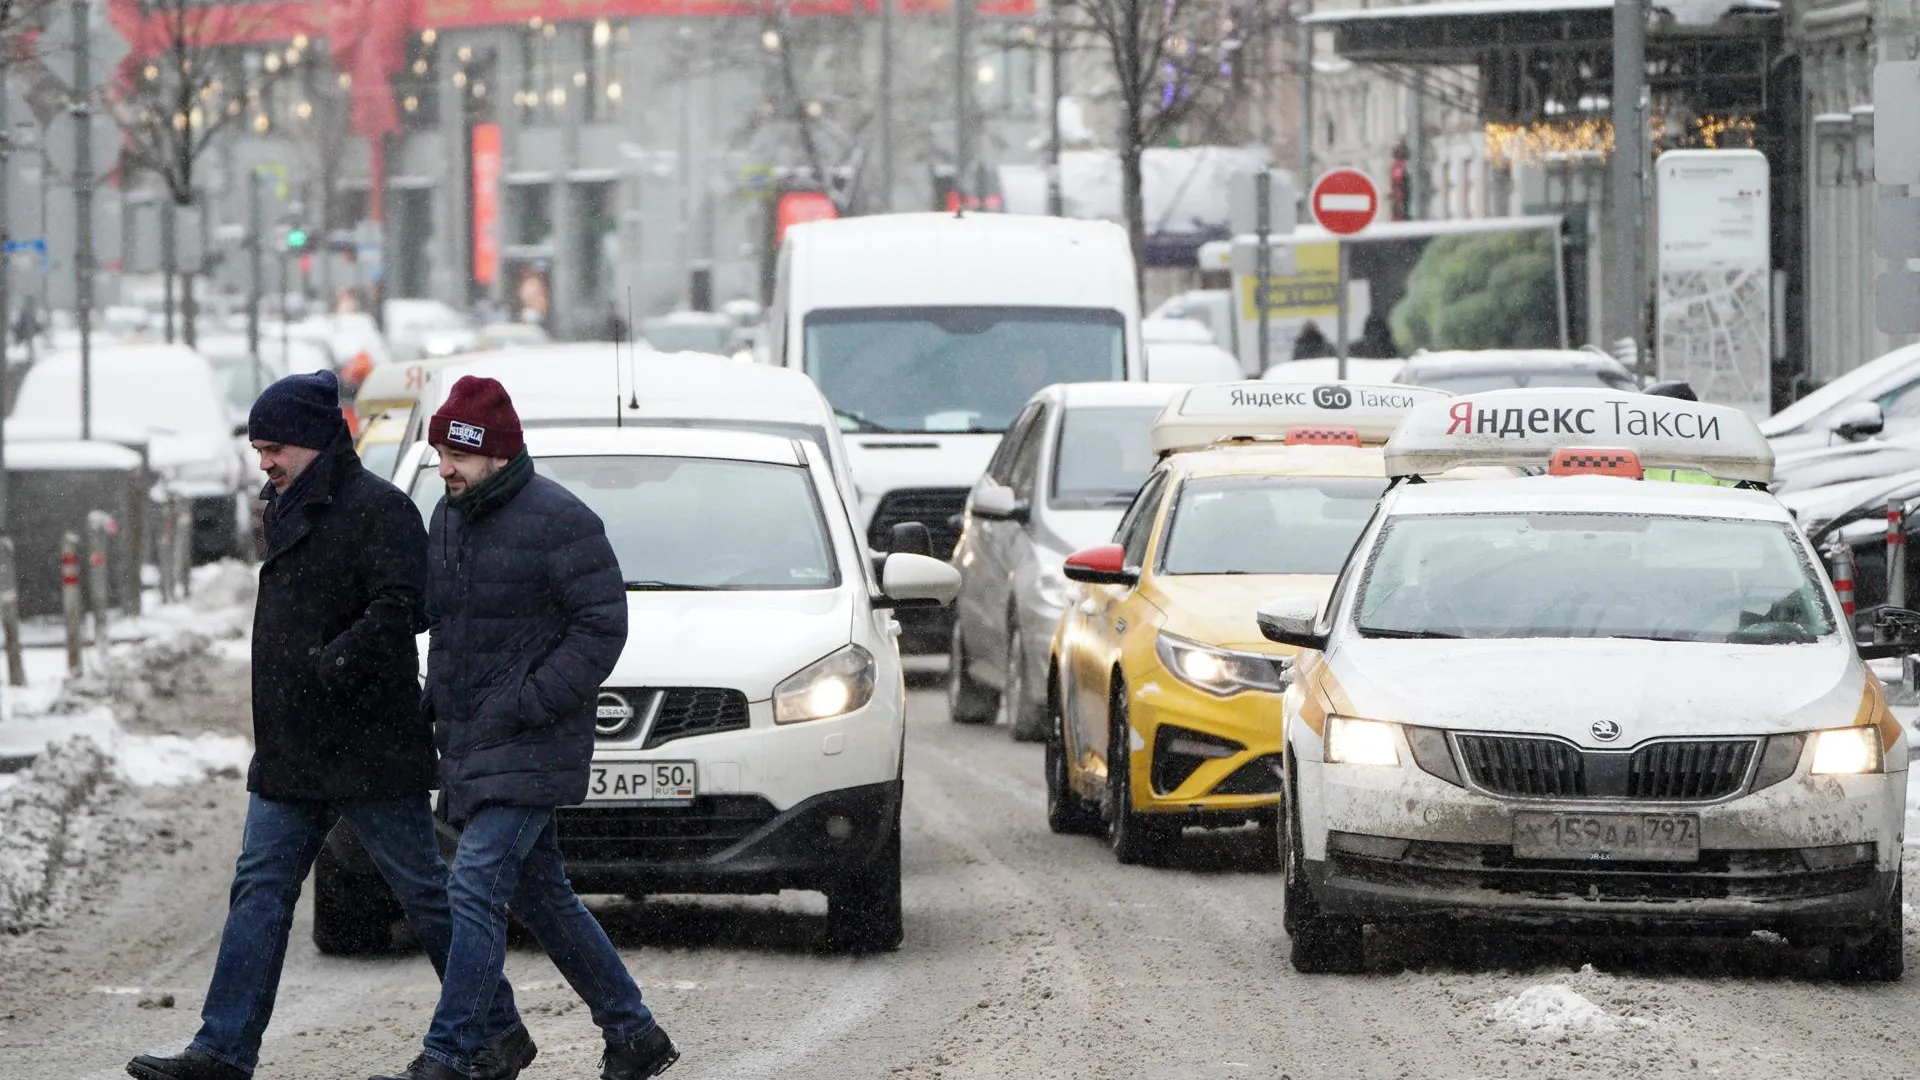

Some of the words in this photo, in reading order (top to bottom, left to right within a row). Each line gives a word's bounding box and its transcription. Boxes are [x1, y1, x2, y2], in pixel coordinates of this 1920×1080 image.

[1231, 389, 1307, 407] Яндекс
[1317, 387, 1348, 407] Go
[1356, 389, 1414, 408] Такси
[1446, 401, 1595, 438] Яндекс
[1605, 400, 1720, 440] Такси
[598, 708, 628, 716] SSAN
[591, 768, 647, 795] 3АР
[657, 766, 684, 786] 50
[655, 787, 677, 796] RUS
[1646, 818, 1690, 843] 797
